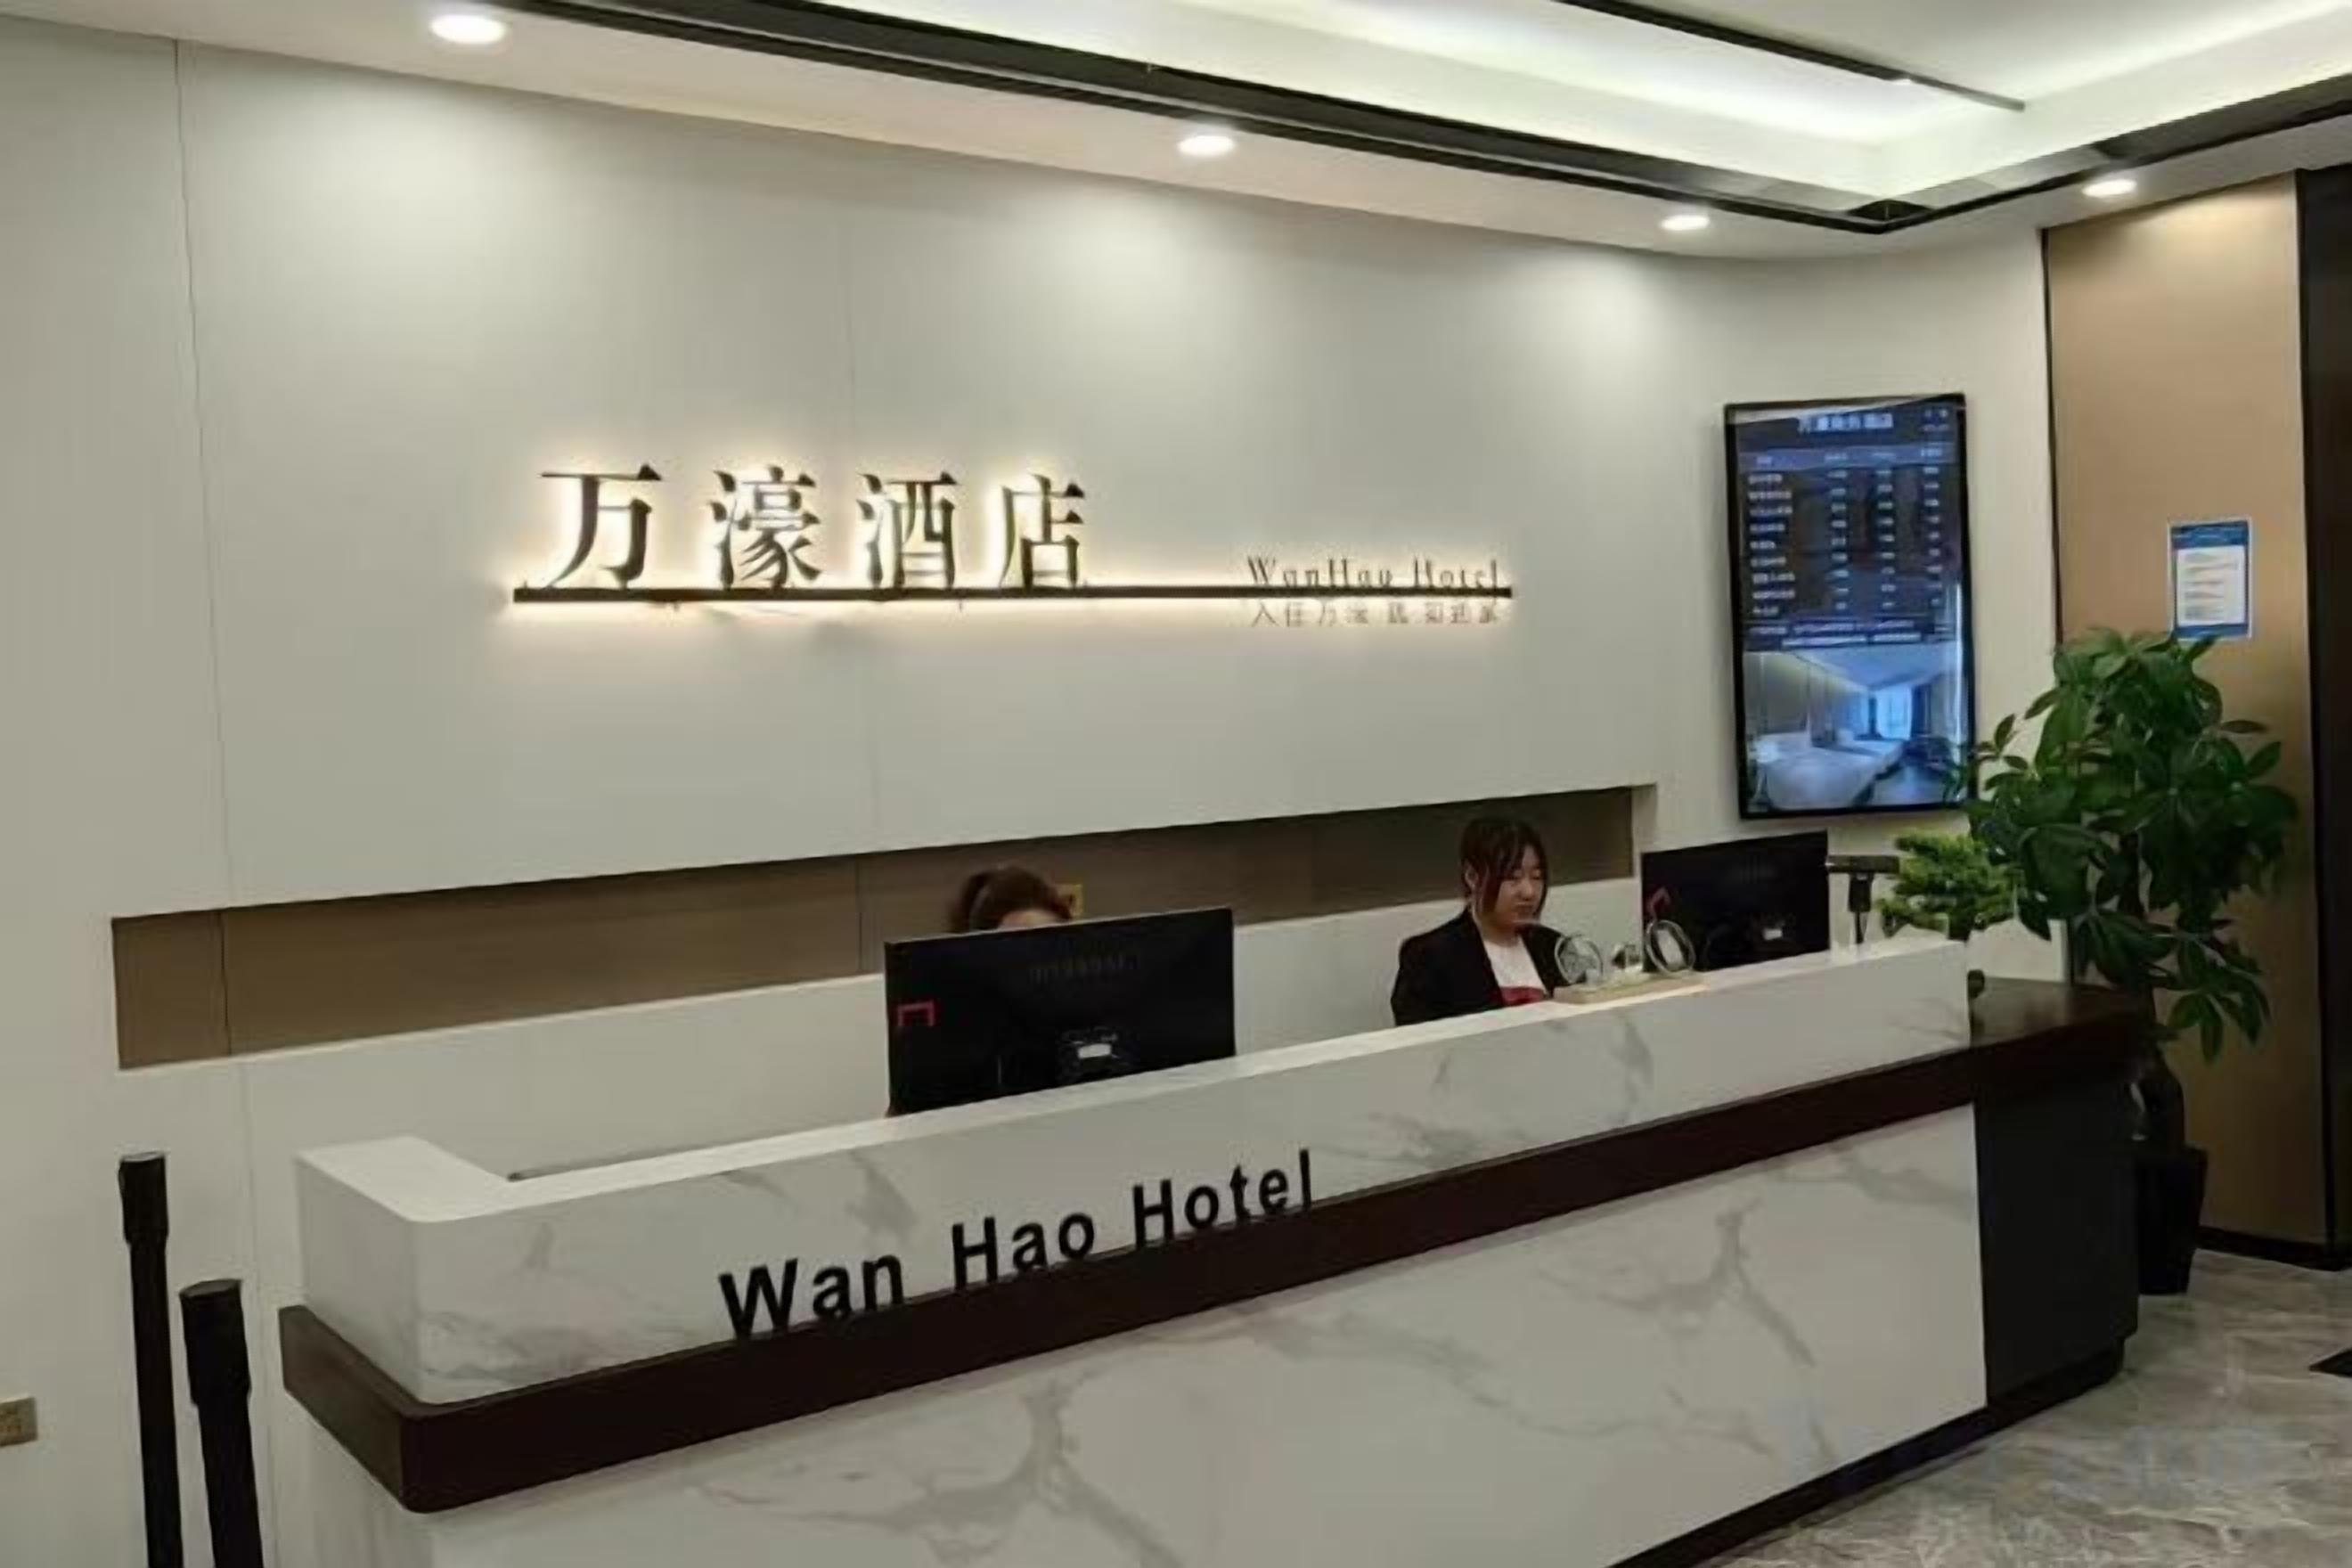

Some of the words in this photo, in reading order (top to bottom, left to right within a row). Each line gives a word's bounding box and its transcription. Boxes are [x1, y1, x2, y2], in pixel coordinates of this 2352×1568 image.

[539, 463, 1087, 590] 万濠酒店
[719, 1254, 904, 1337] Wan
[951, 1212, 1096, 1291] Hao
[1132, 1148, 1311, 1245] Hotel
